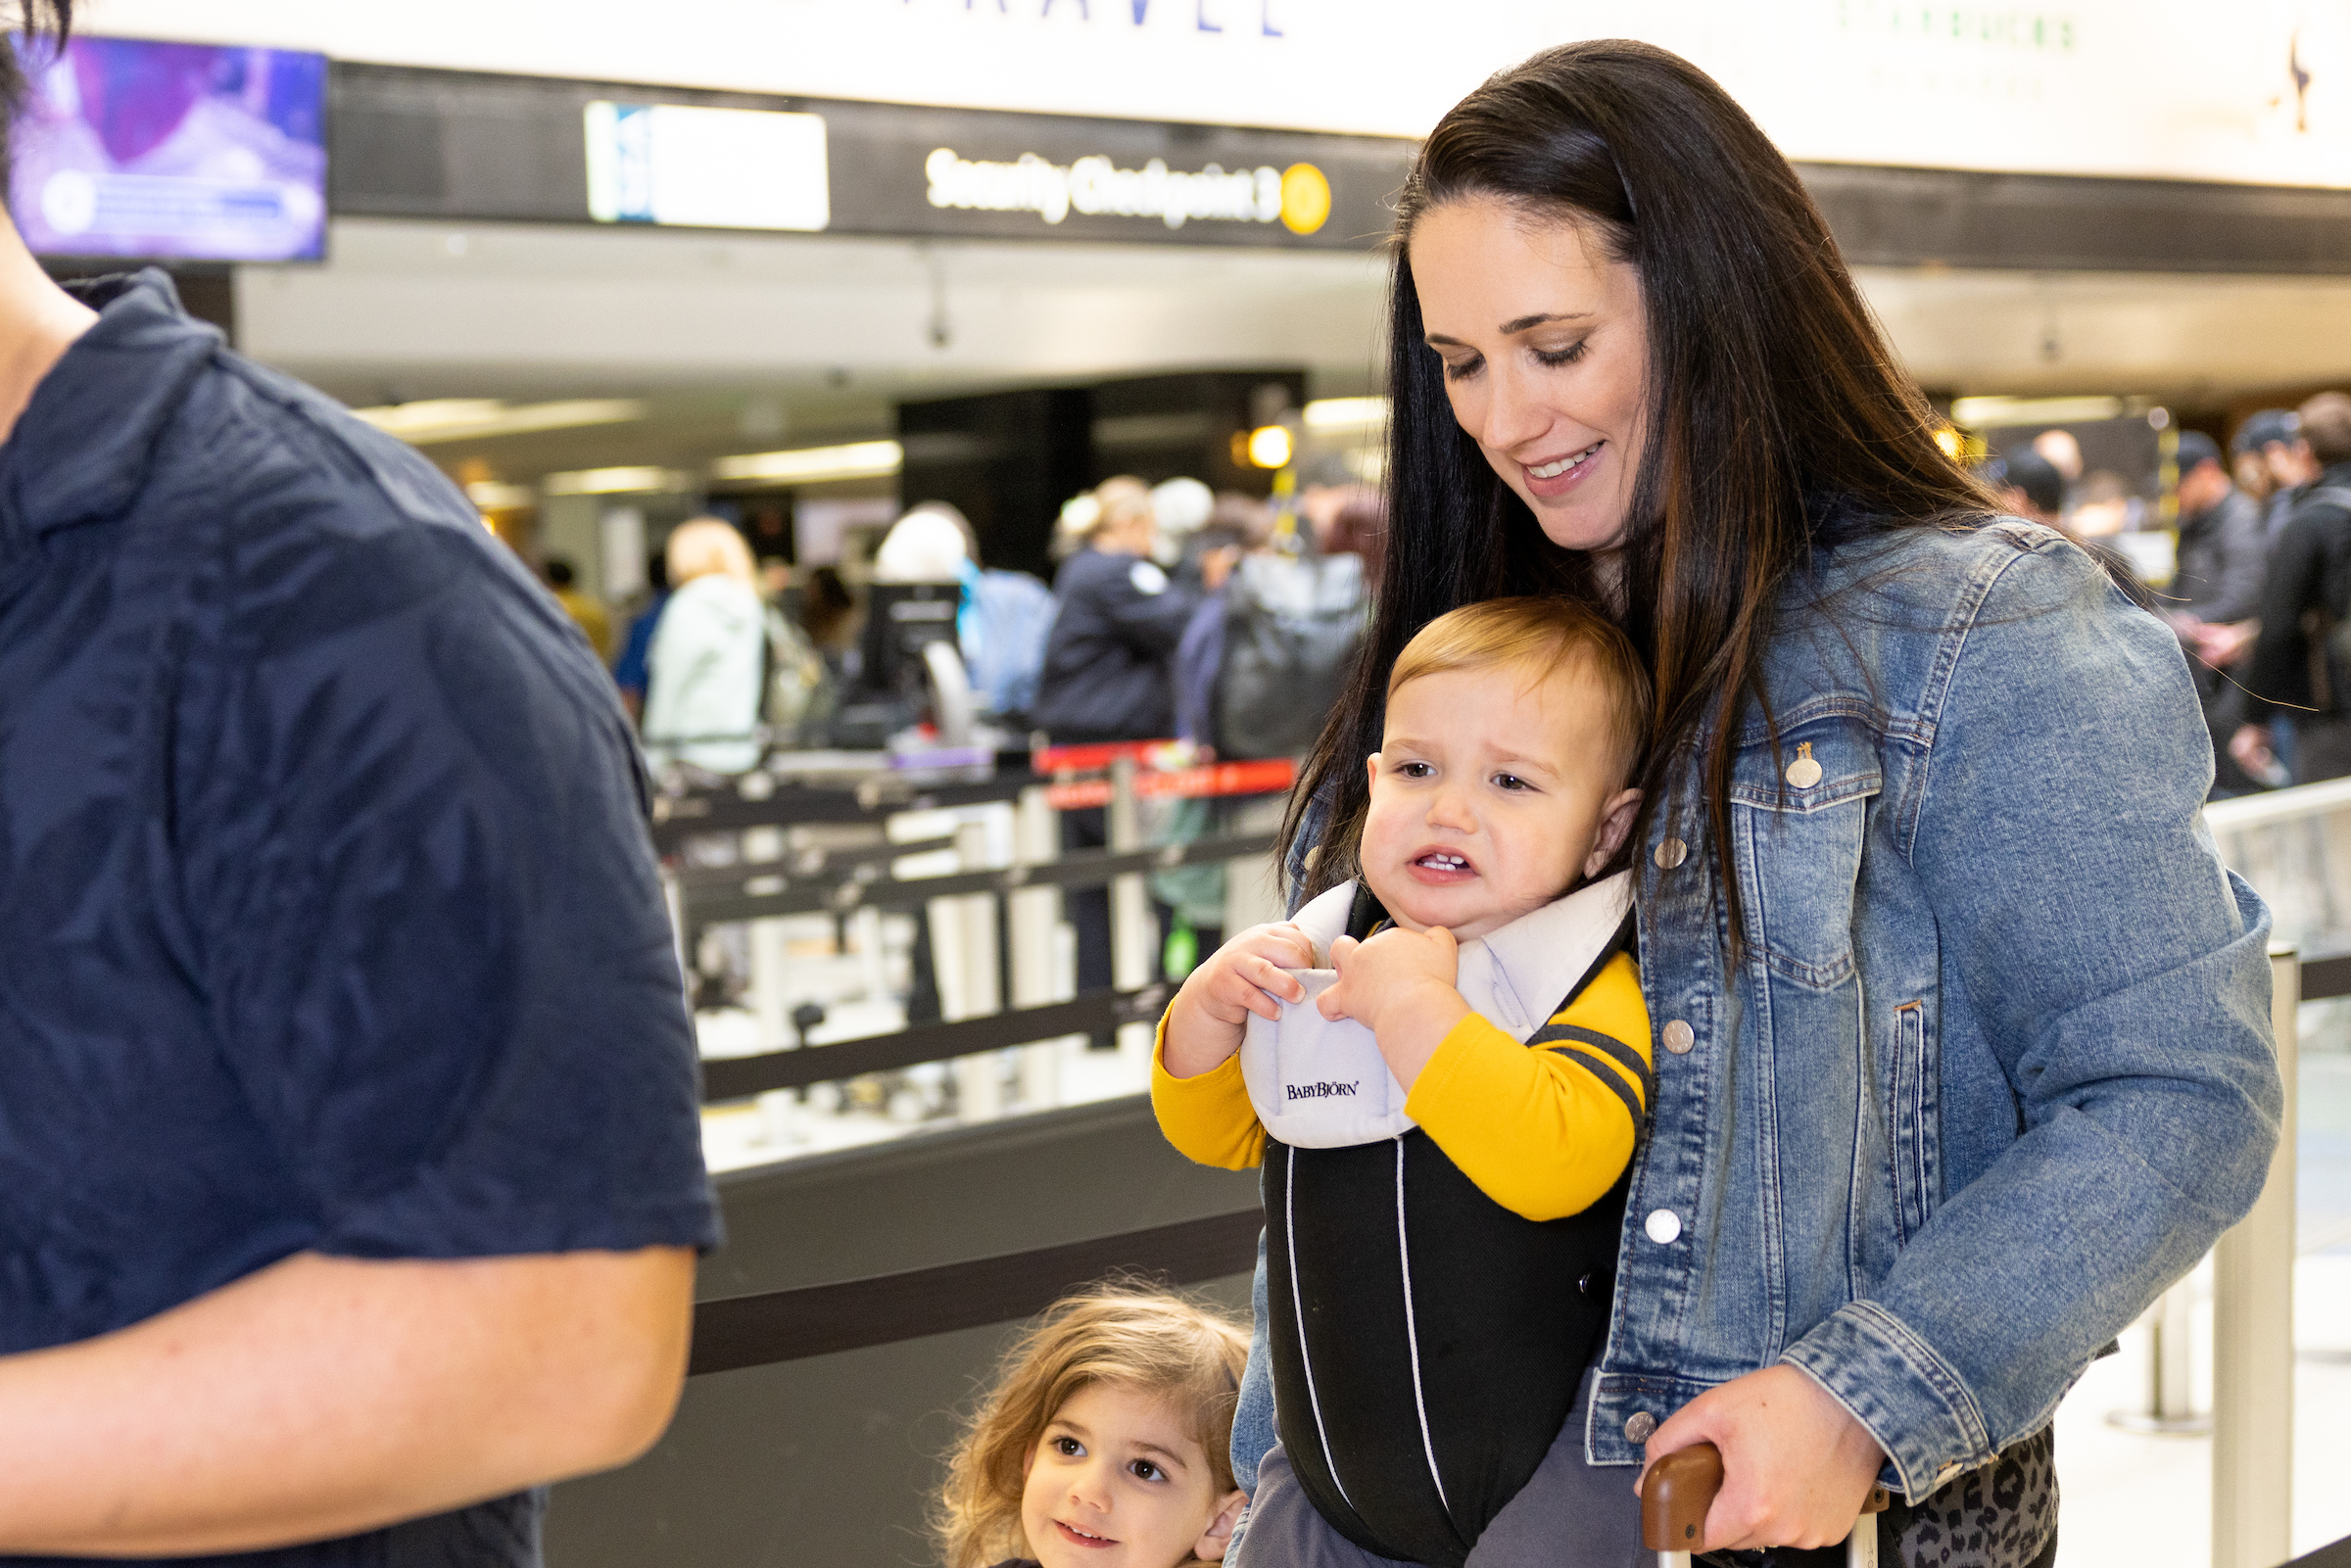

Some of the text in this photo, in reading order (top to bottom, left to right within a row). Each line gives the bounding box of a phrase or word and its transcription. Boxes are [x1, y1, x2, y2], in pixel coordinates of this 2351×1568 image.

[926, 148, 1282, 229] Security Checkpoint 3
